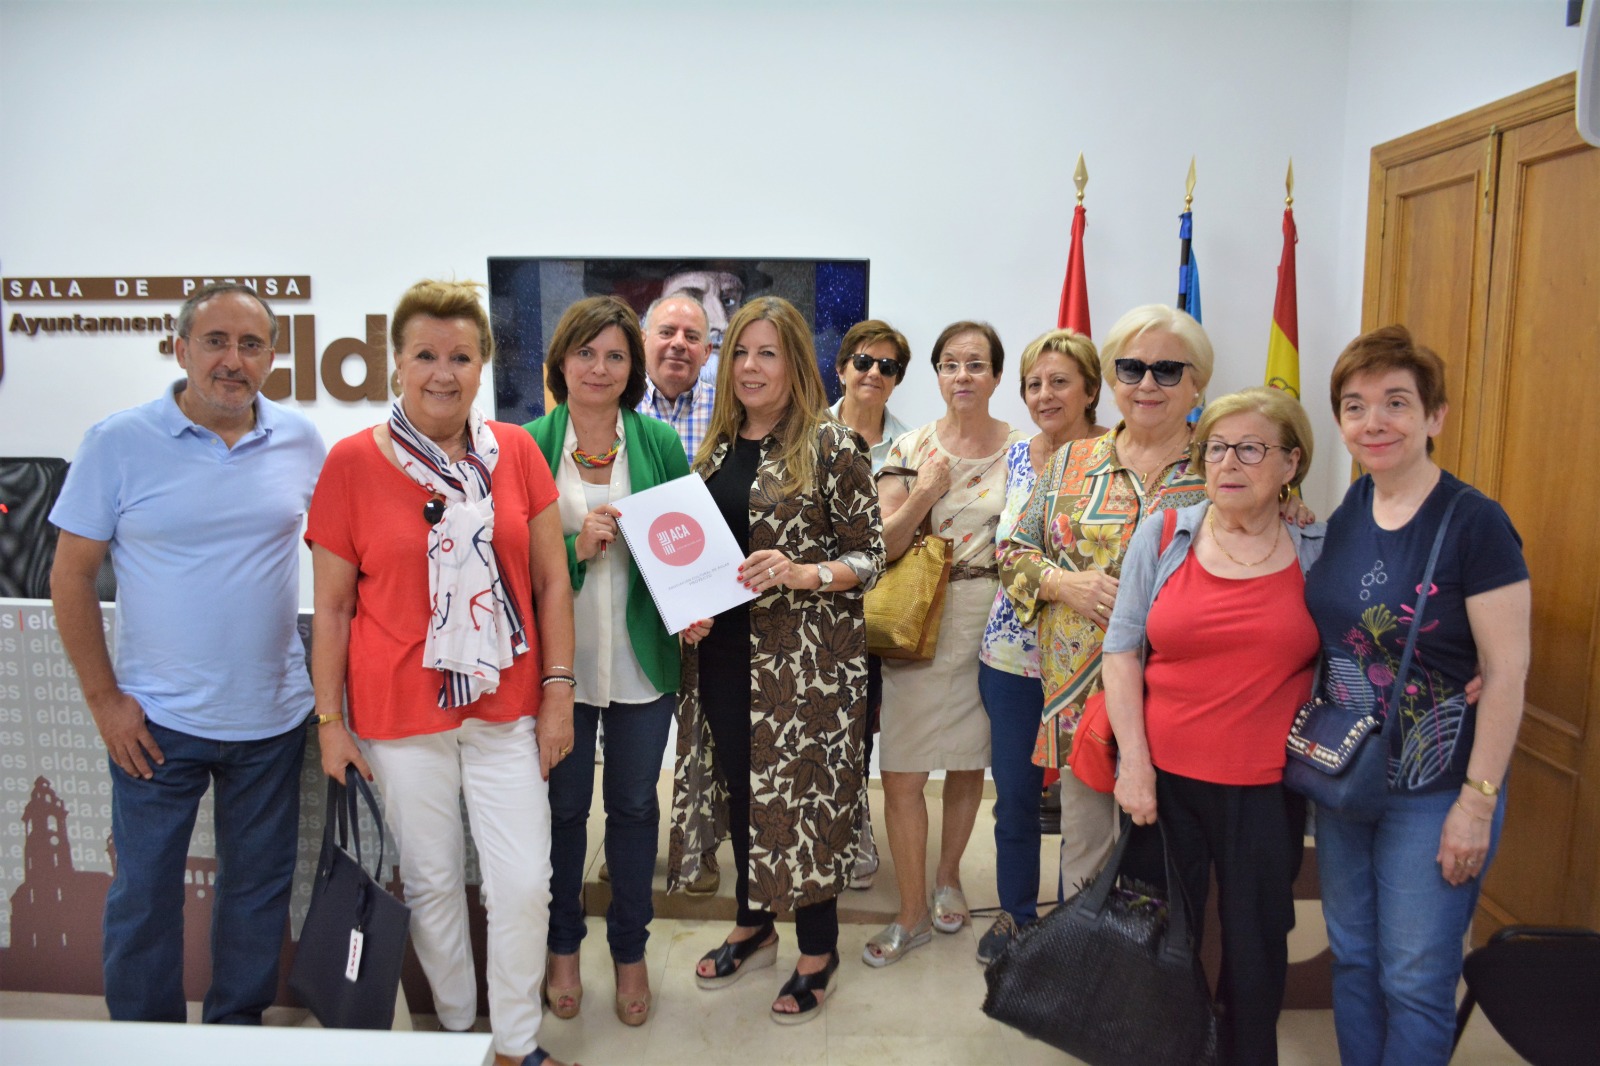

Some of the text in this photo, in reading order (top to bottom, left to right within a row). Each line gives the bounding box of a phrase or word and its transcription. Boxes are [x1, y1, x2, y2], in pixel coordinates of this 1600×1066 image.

[10, 278, 301, 297] SALA DE PNSA
[9, 313, 178, 336] Ayuntamient
[670, 524, 691, 541] ACA
